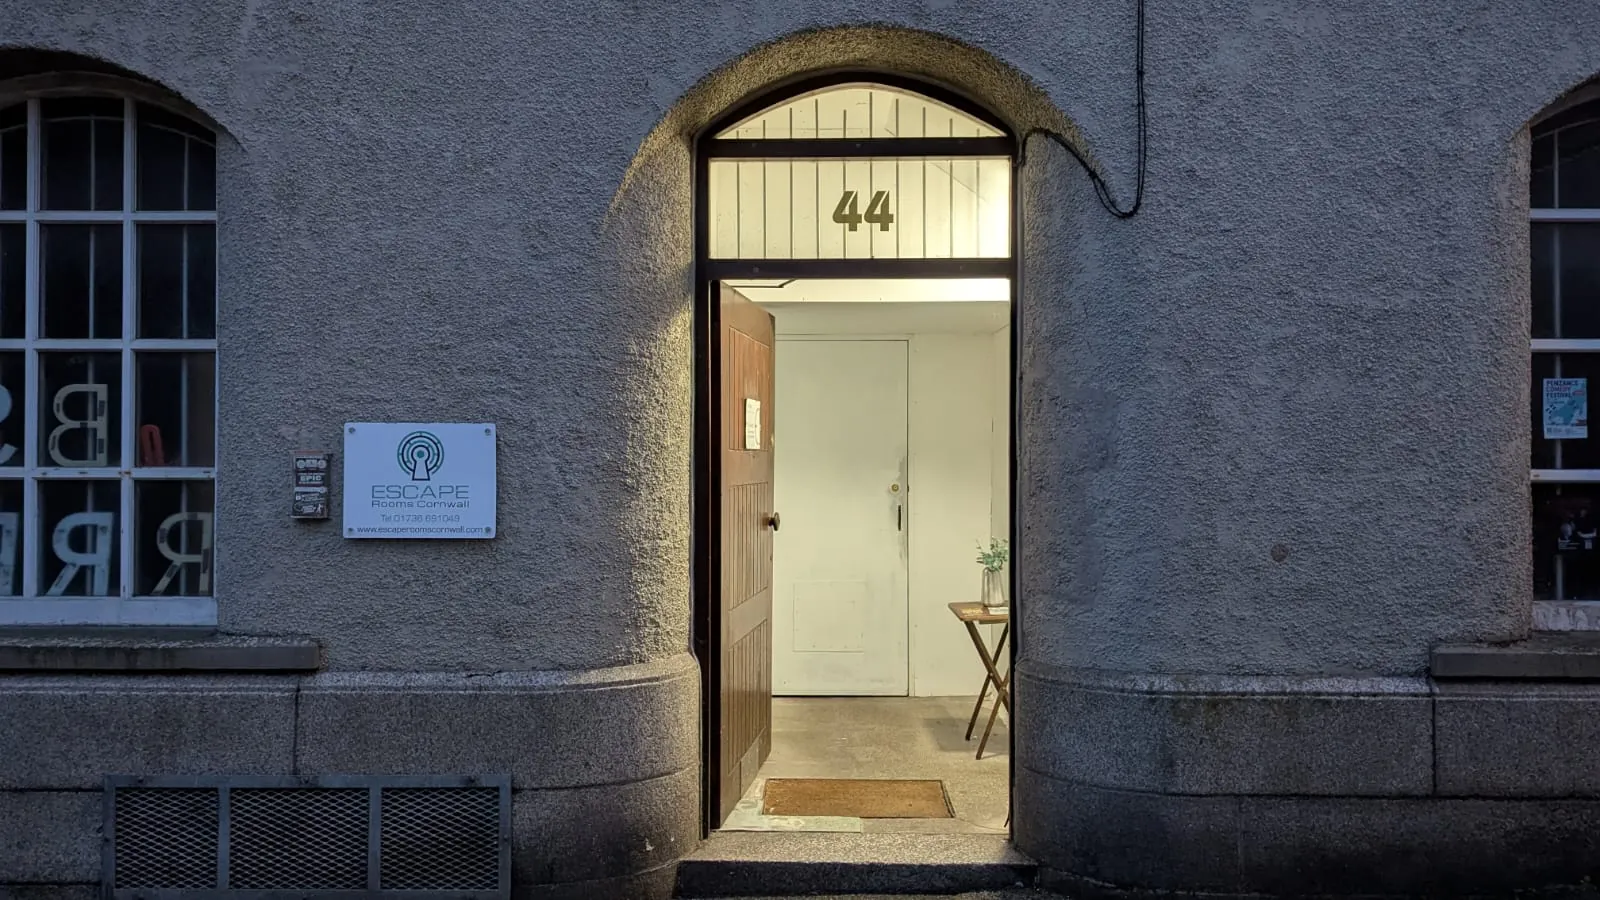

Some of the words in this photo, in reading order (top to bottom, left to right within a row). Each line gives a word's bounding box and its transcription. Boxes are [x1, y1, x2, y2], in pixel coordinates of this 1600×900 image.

[832, 190, 894, 232] 44
[371, 485, 470, 499] ESCAPE
[371, 500, 414, 508] Rooms
[416, 500, 470, 508] Cornwall
[393, 514, 423, 523] 01736
[425, 514, 460, 523] 691049
[356, 525, 484, 534] www.escaperoomscornwall.com
